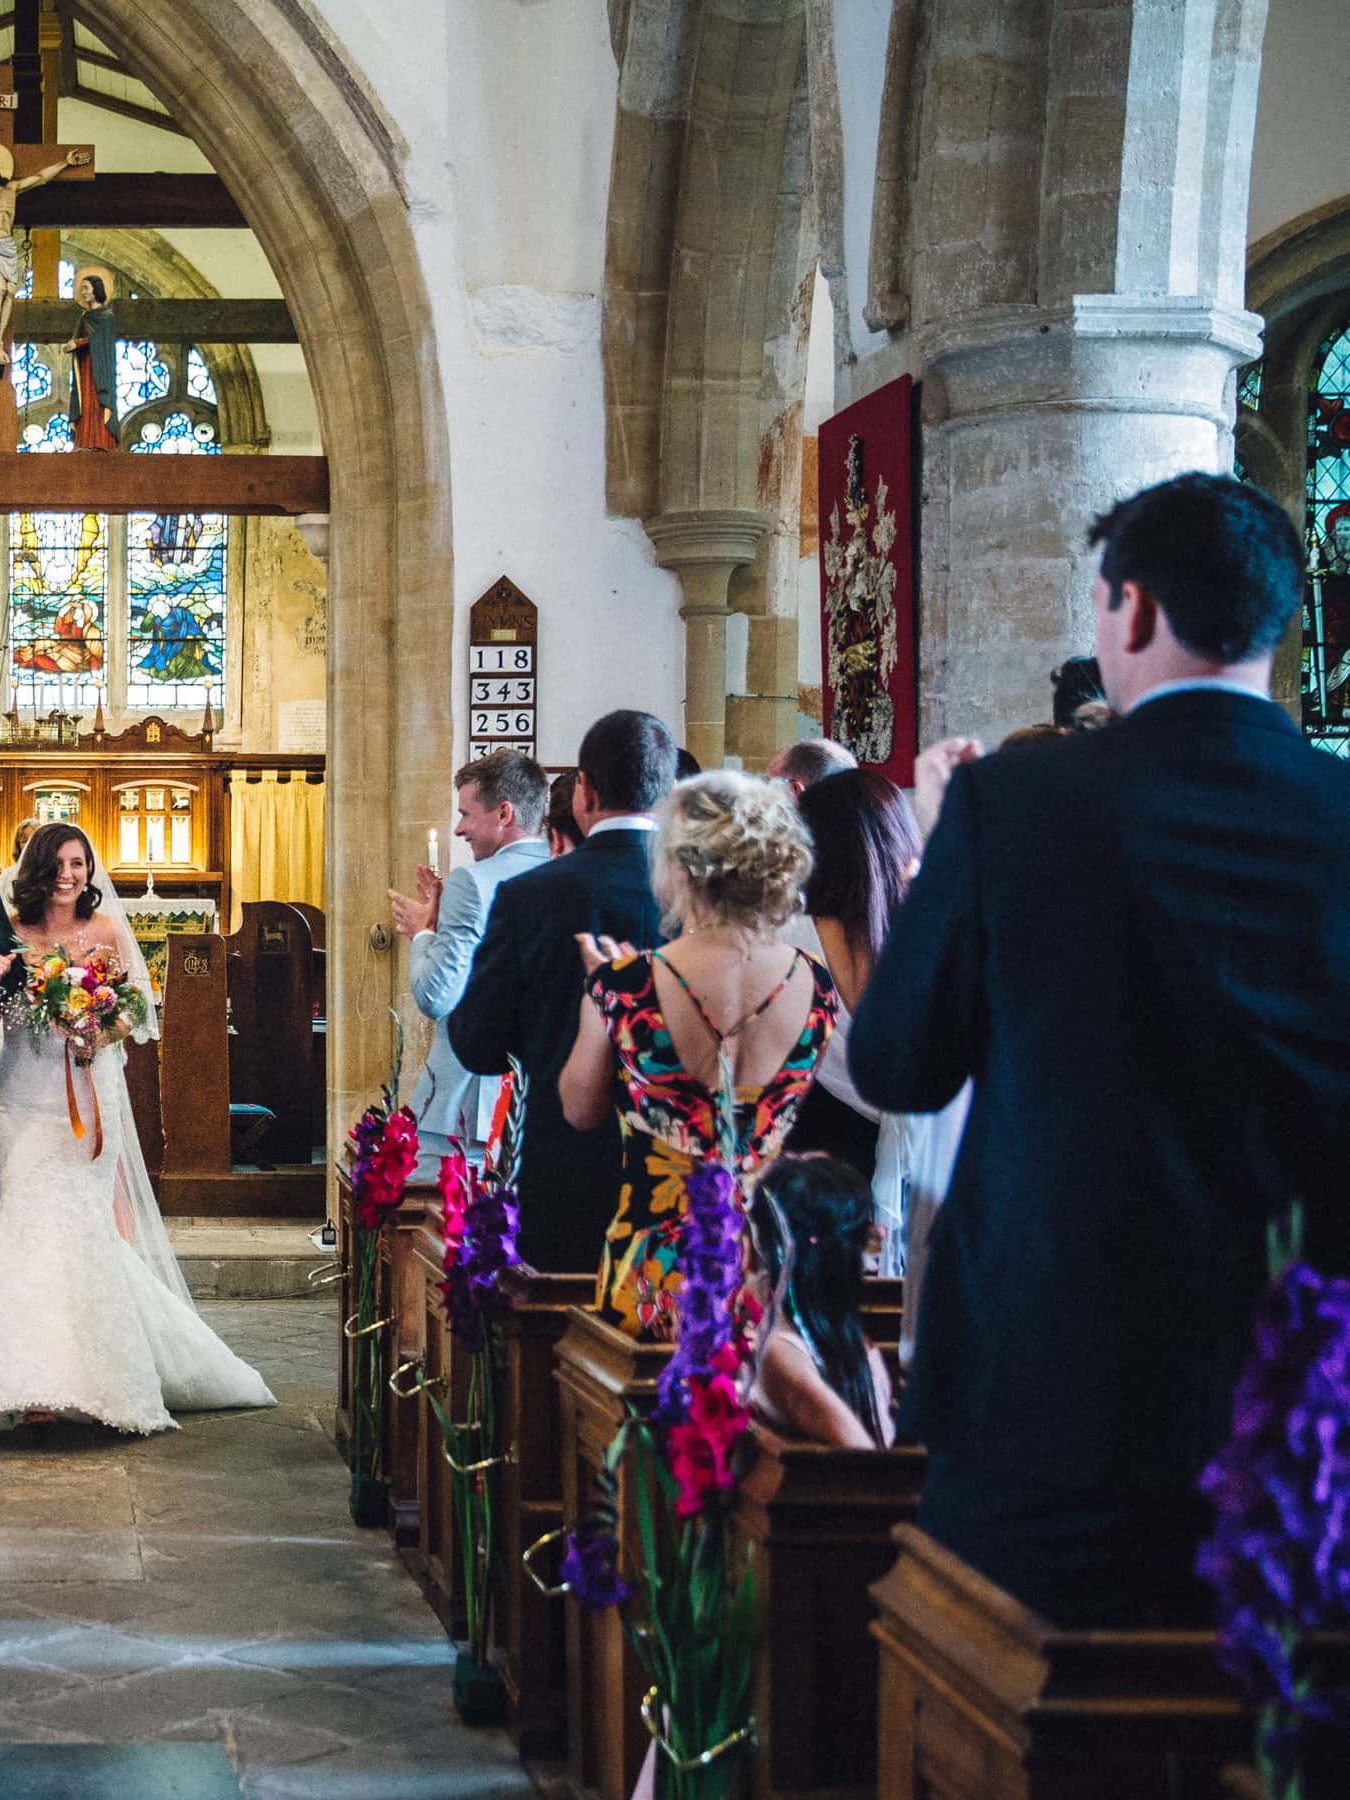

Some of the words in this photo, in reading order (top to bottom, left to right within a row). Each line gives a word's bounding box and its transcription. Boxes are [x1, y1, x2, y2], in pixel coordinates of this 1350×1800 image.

[476, 649, 528, 669] 118
[475, 682, 531, 702] 343
[476, 713, 530, 732] 256
